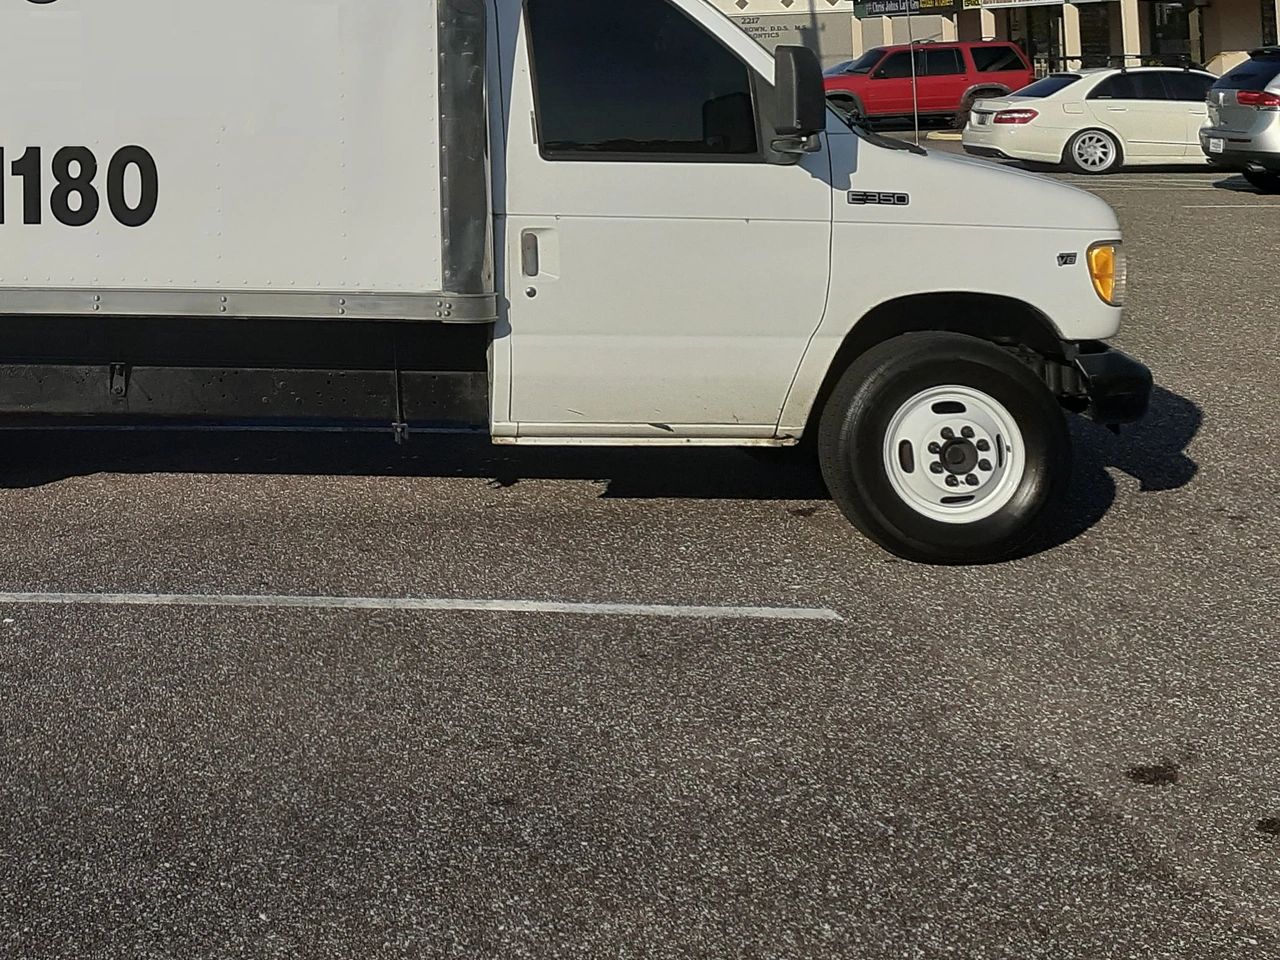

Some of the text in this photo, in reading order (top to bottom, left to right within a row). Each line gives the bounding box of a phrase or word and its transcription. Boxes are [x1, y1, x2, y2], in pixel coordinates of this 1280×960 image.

[872, 1, 885, 13] Chris
[741, 17, 760, 25] 2217
[848, 191, 908, 205] E350
